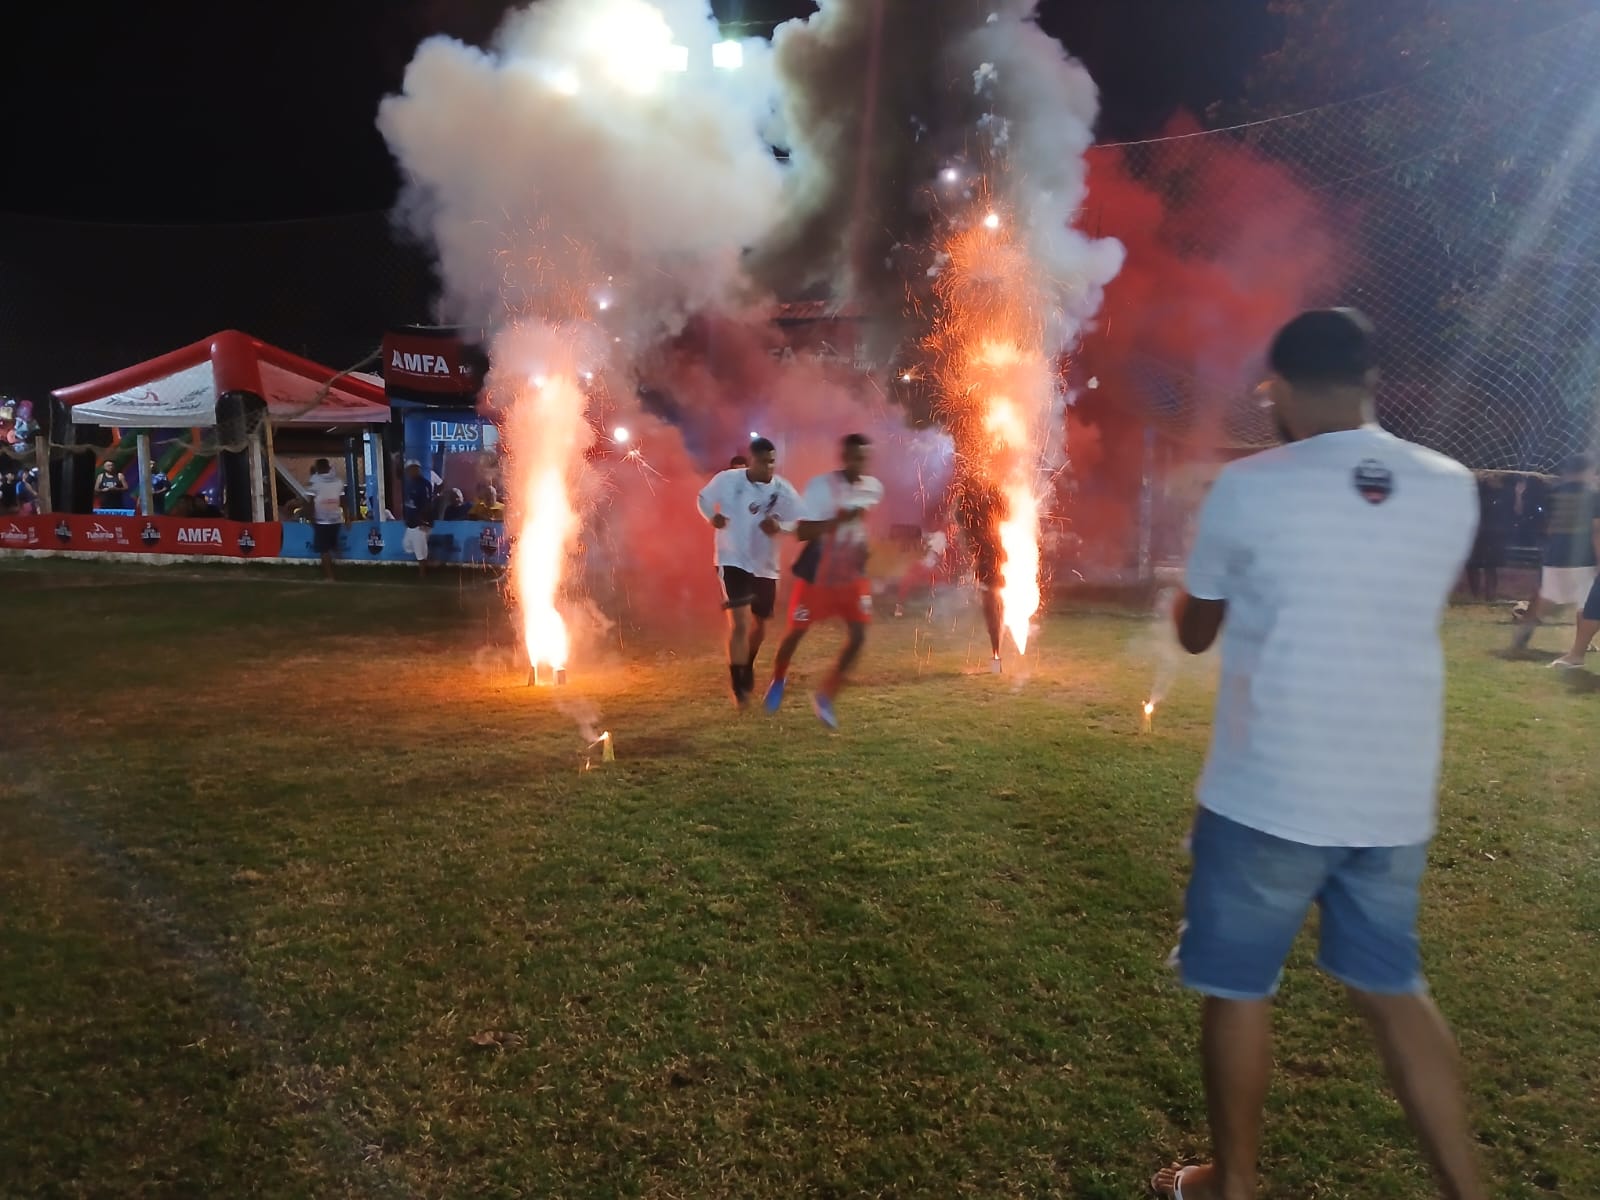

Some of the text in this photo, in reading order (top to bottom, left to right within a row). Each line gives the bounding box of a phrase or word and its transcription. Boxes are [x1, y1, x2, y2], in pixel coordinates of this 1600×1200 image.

[391, 349, 450, 374] AMFA
[430, 421, 478, 442] LLAS
[177, 527, 223, 543] AMFA
